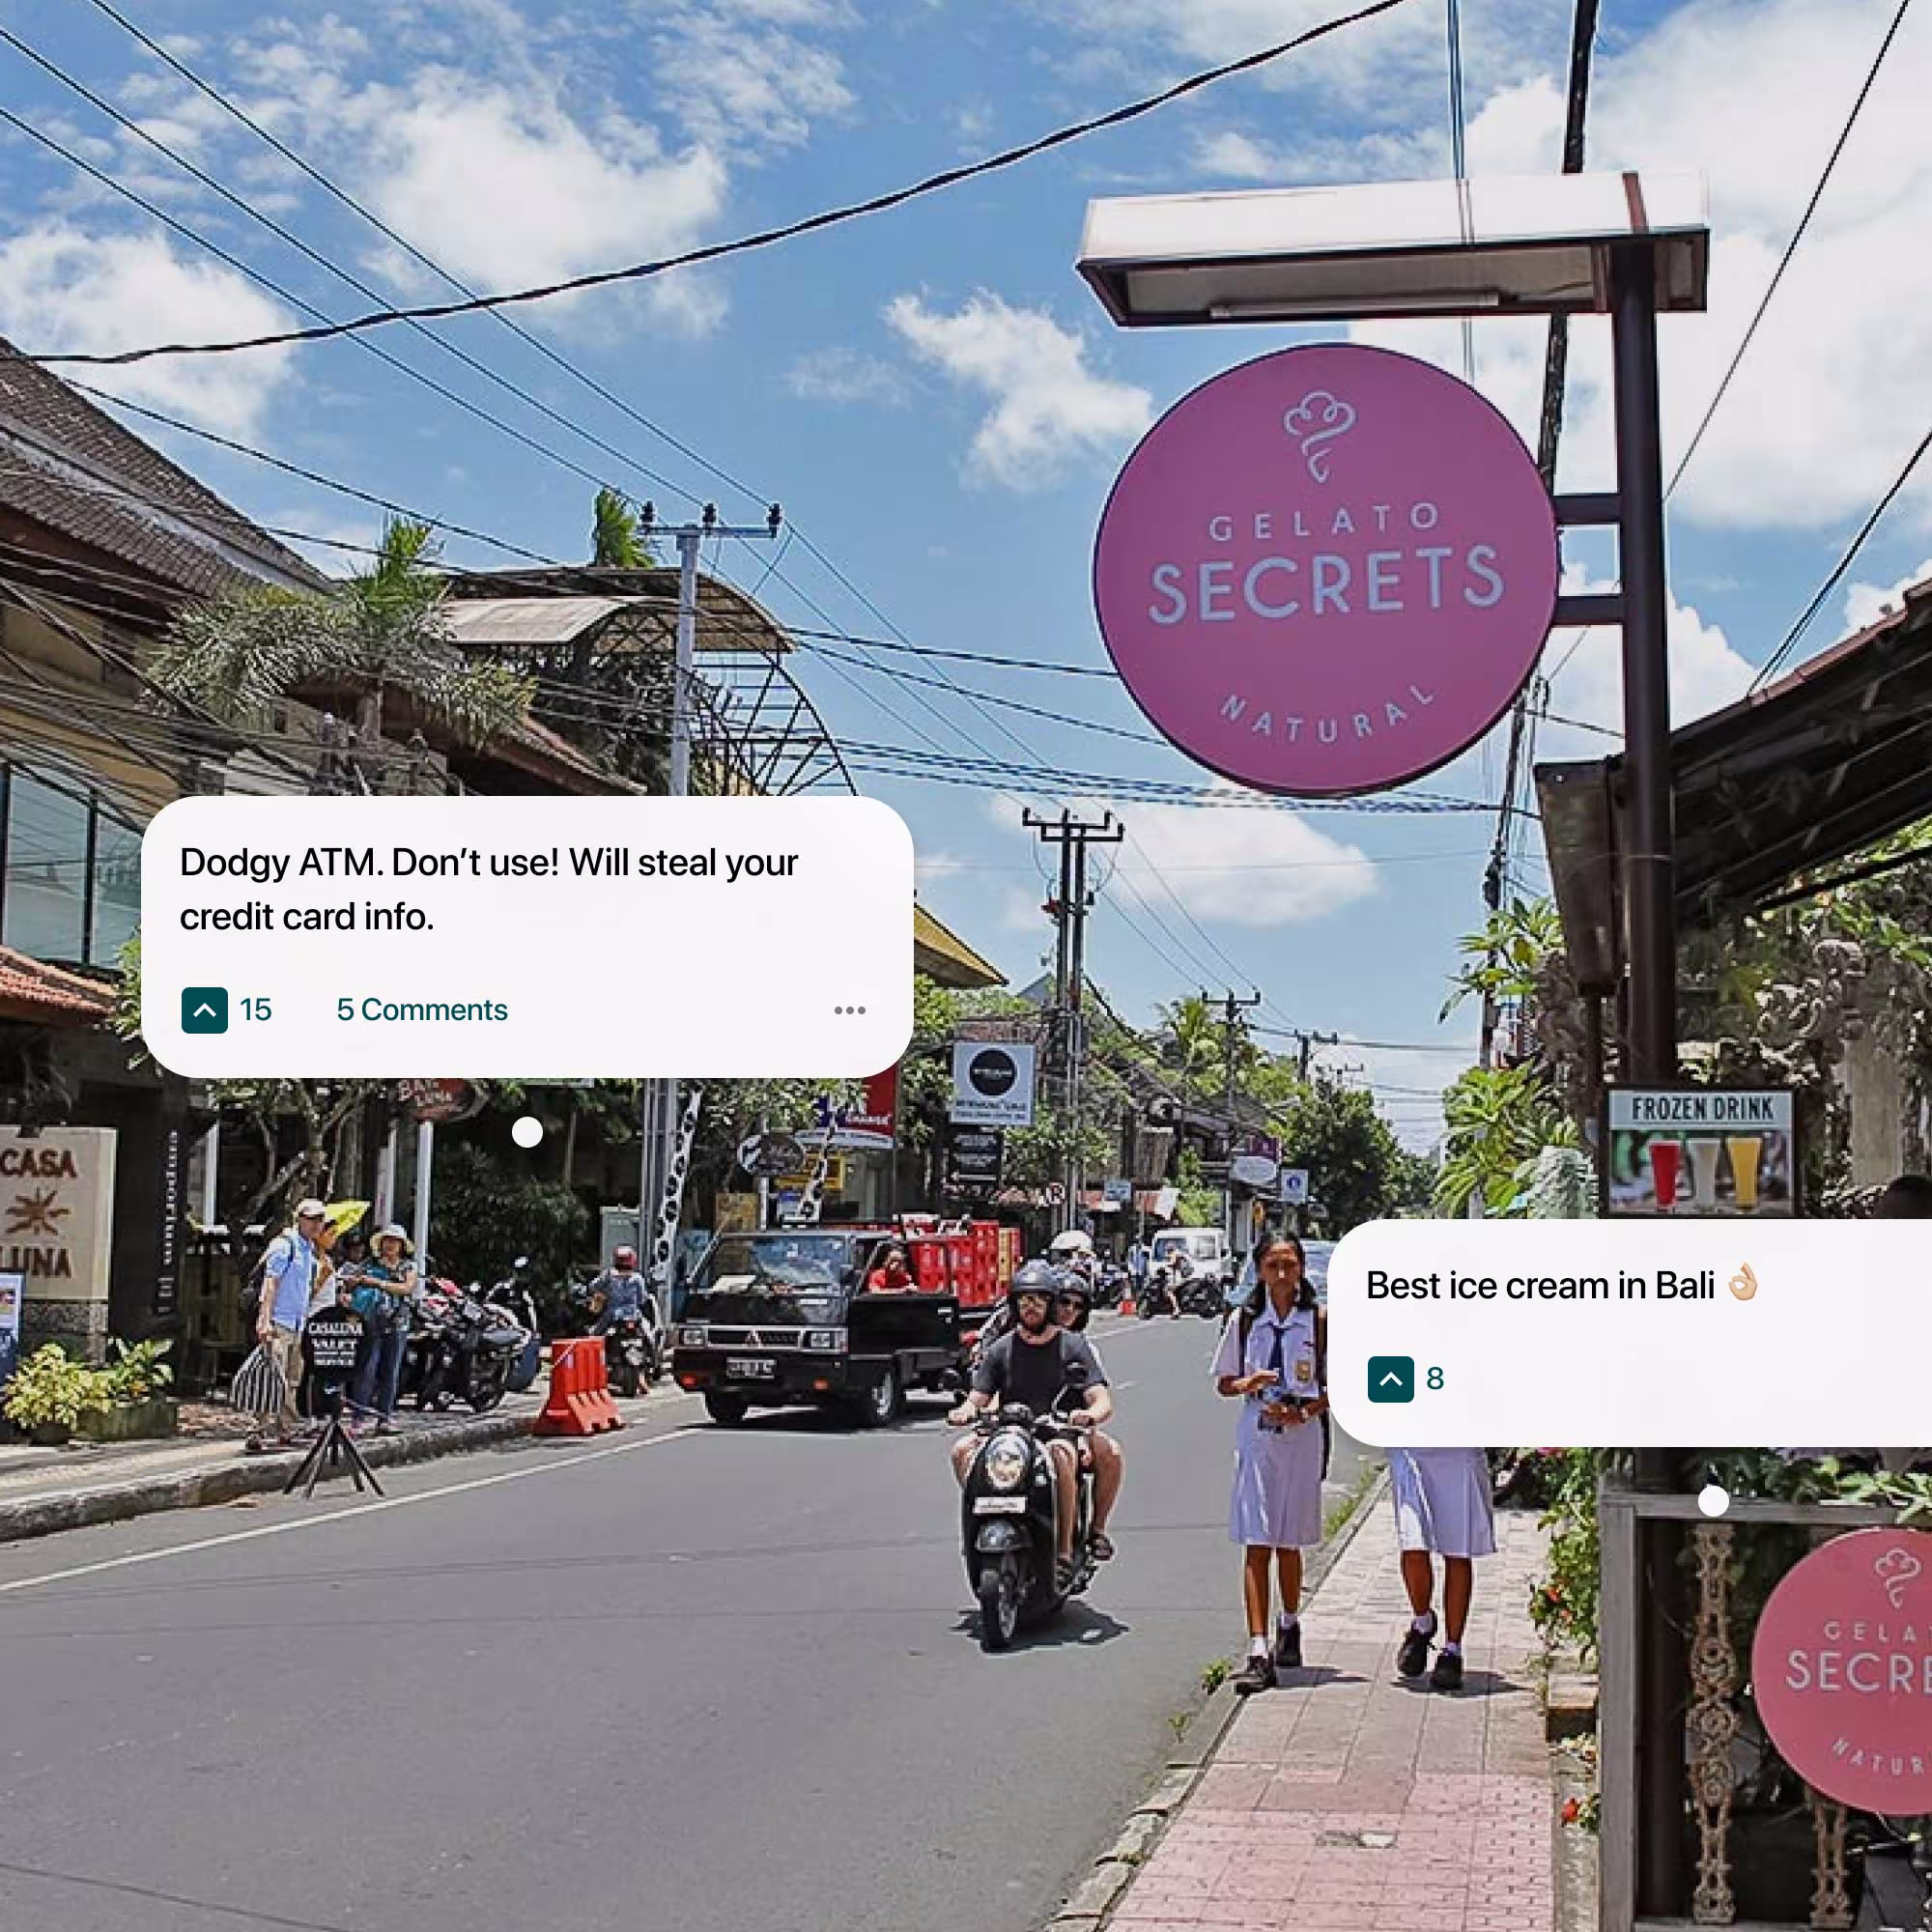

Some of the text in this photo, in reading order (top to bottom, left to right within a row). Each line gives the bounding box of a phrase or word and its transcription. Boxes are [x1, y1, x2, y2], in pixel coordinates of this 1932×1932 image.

[1209, 502, 1439, 541] GELATO
[1149, 545, 1503, 624] SECRETS
[1220, 685, 1435, 743] NATURAL
[1632, 1096, 1775, 1121] FROZEN DRINK
[0, 1148, 77, 1179] CASA
[0, 1245, 72, 1279] UNA
[1823, 1620, 1932, 1643] GELA
[1832, 1737, 1925, 1776] NATUR
